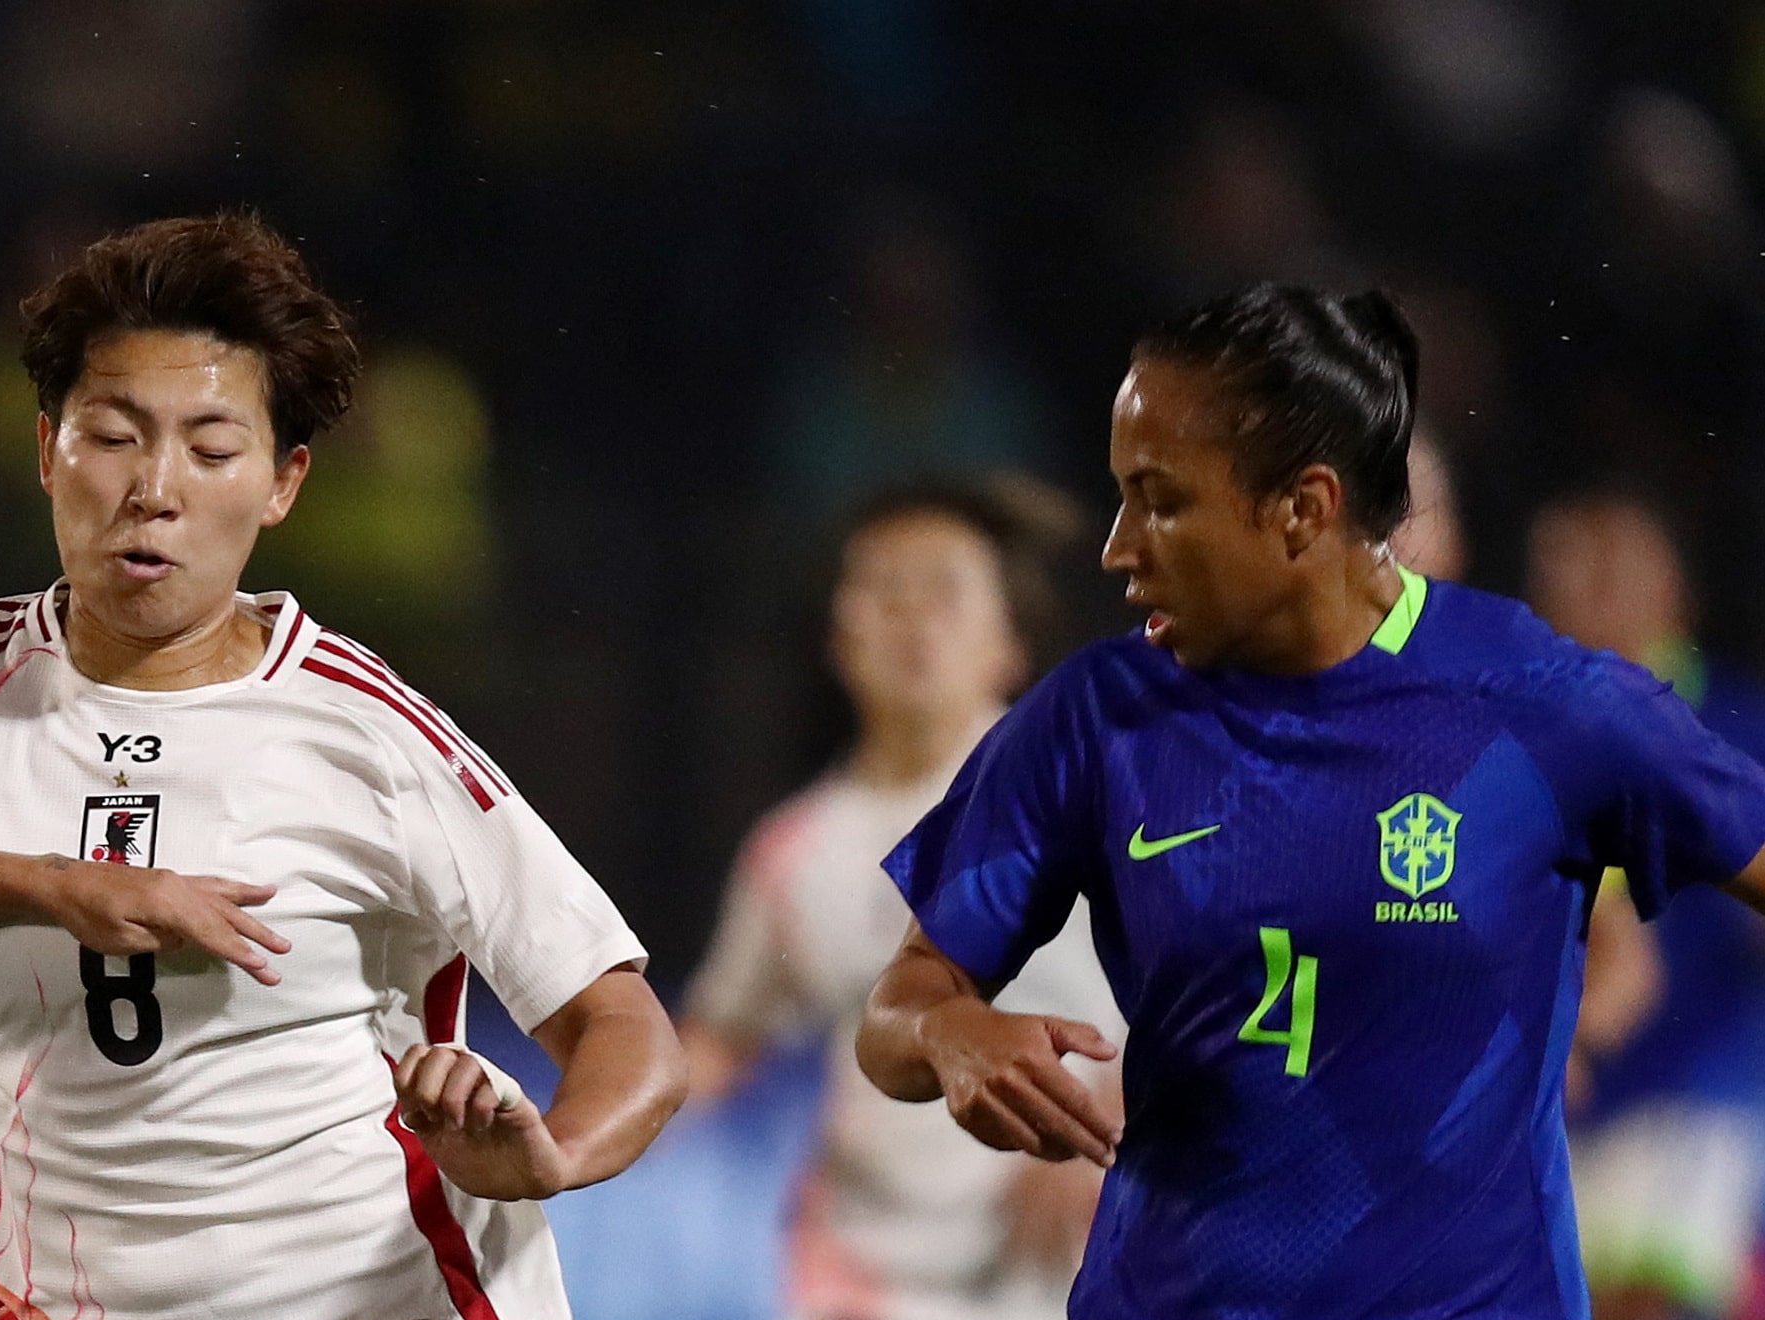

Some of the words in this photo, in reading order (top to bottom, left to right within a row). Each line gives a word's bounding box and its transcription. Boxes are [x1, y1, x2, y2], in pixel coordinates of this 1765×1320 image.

[97, 732, 162, 763] Y-3
[102, 797, 143, 806] JAPAN
[1375, 902, 1460, 922] BRASIL
[79, 943, 163, 1067] 8
[1237, 926, 1319, 1079] 4
